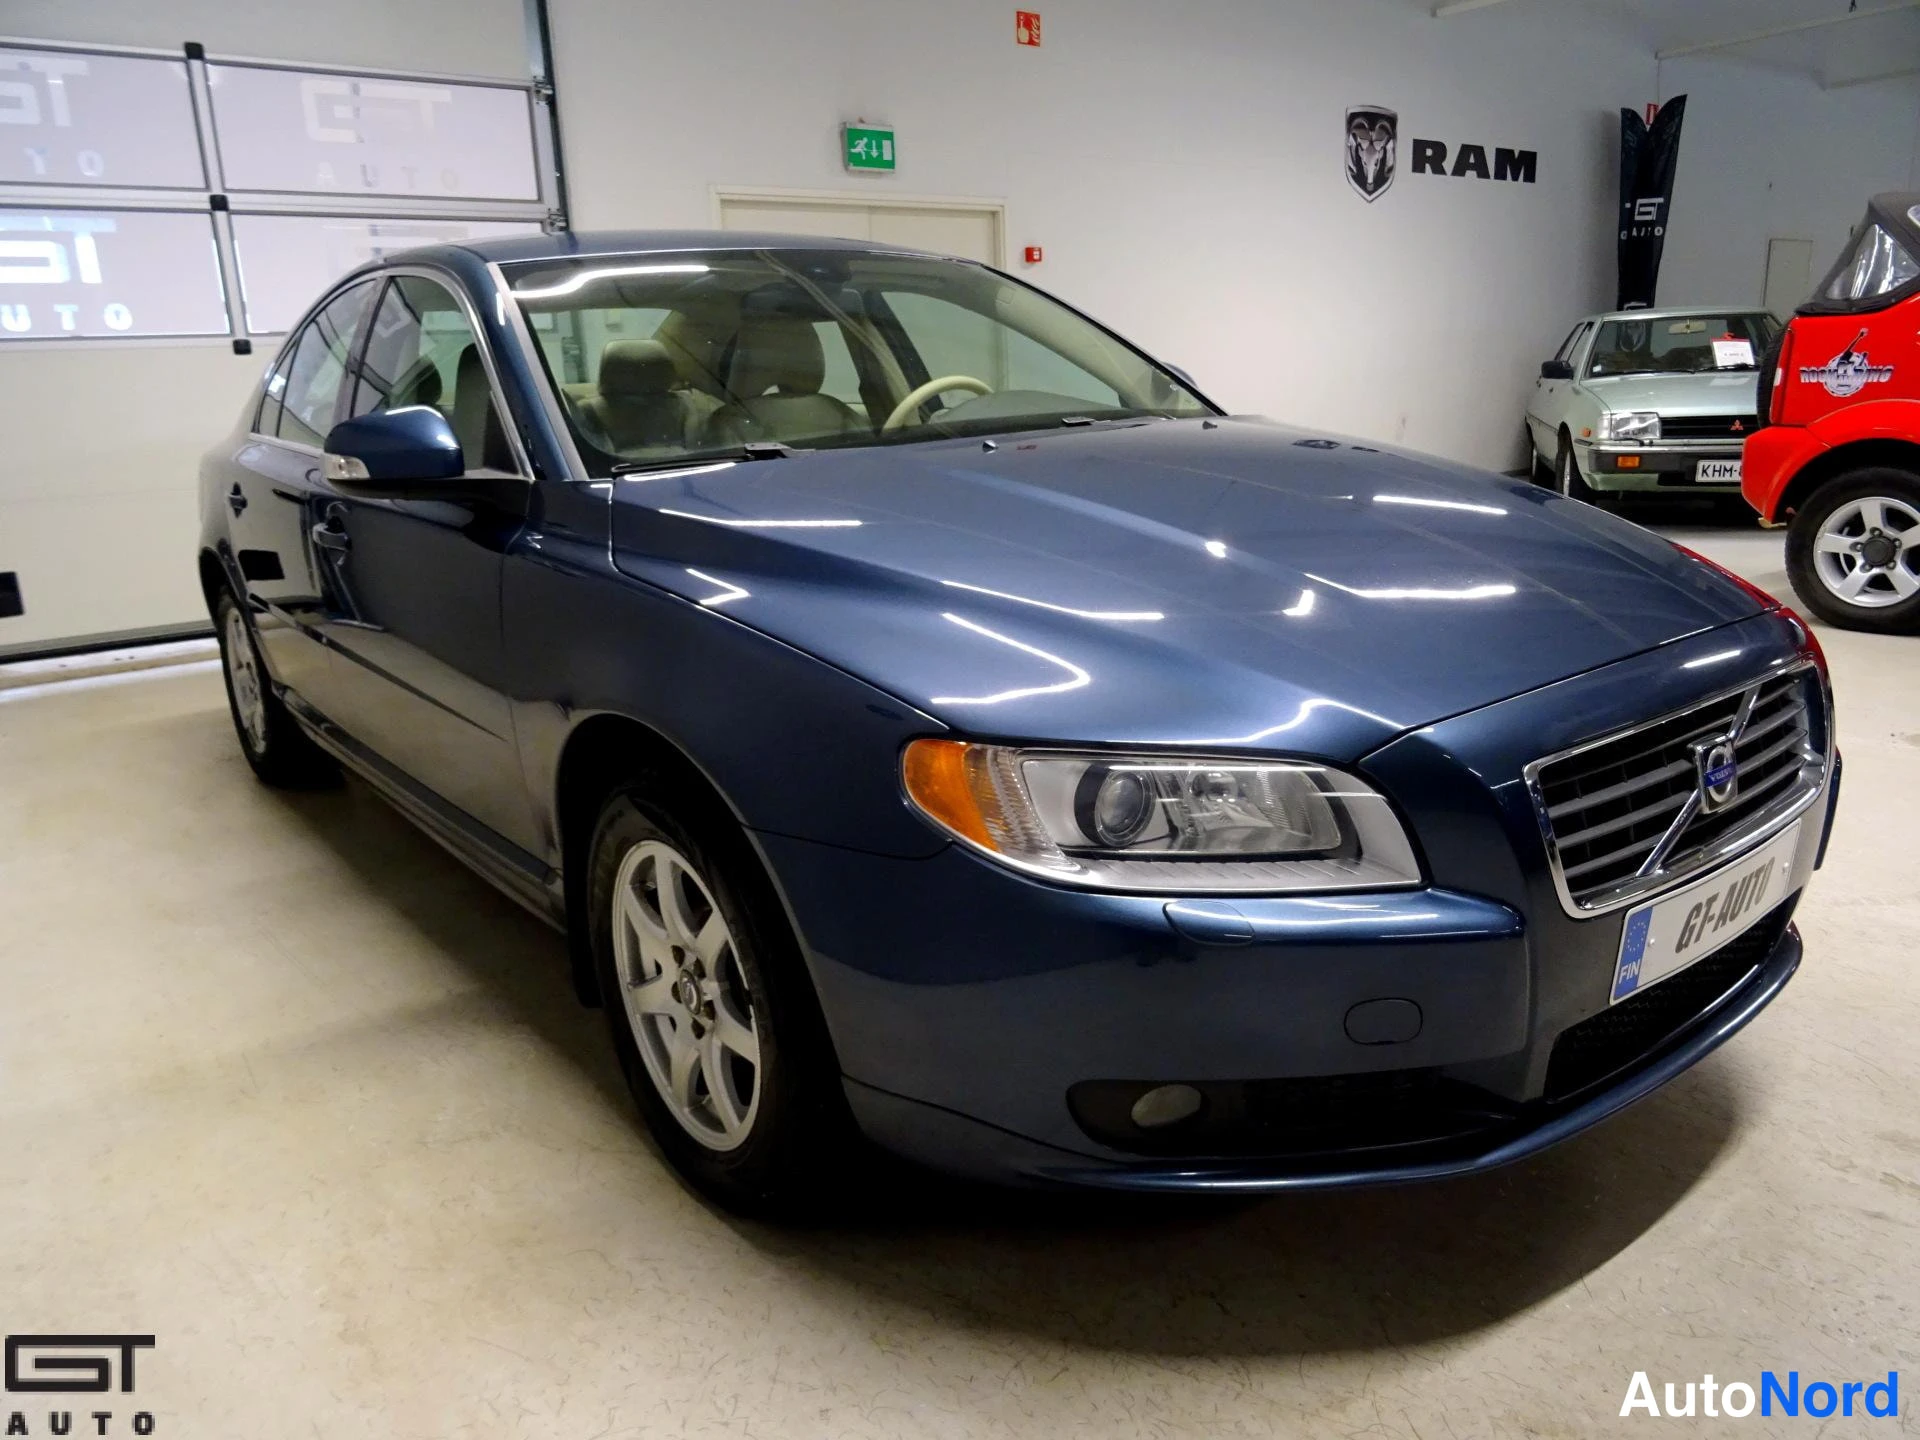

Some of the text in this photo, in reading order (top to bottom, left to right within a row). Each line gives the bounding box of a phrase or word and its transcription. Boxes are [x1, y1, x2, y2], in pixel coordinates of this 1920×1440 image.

[1411, 138, 1538, 184] RAM
[316, 162, 460, 191] AUTO
[0, 303, 133, 332] UTO
[1701, 464, 1742, 478] KHM-
[1675, 856, 1775, 953] GT-AUTO
[1618, 959, 1641, 984] FIN
